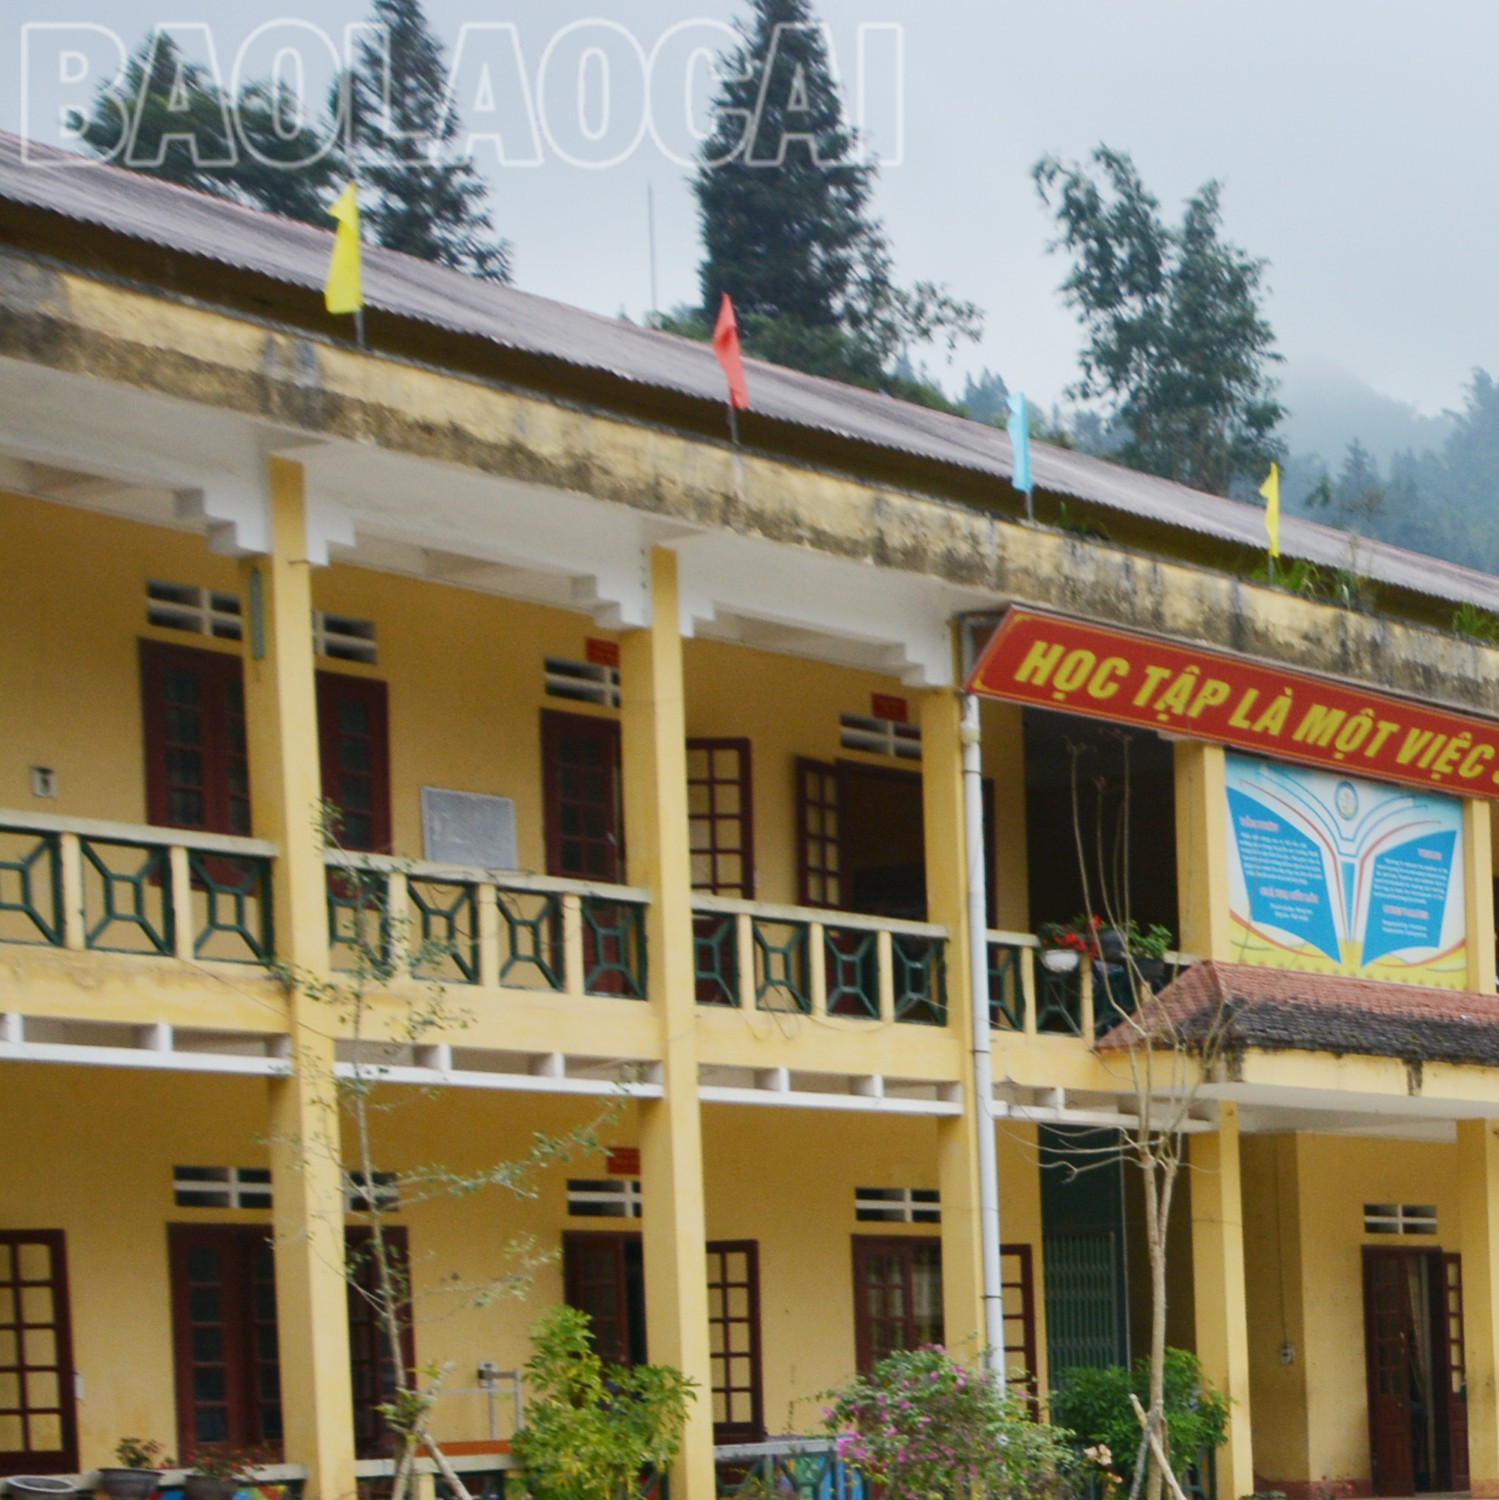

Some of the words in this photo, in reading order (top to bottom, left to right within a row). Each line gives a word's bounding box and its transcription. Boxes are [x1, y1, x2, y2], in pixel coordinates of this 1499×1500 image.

[1013, 640, 1131, 701] HỌC
[1132, 665, 1231, 722] TẬP
[1228, 687, 1293, 737] LÀ
[1292, 703, 1400, 760] MỘT
[1395, 722, 1496, 781] VIỆC
